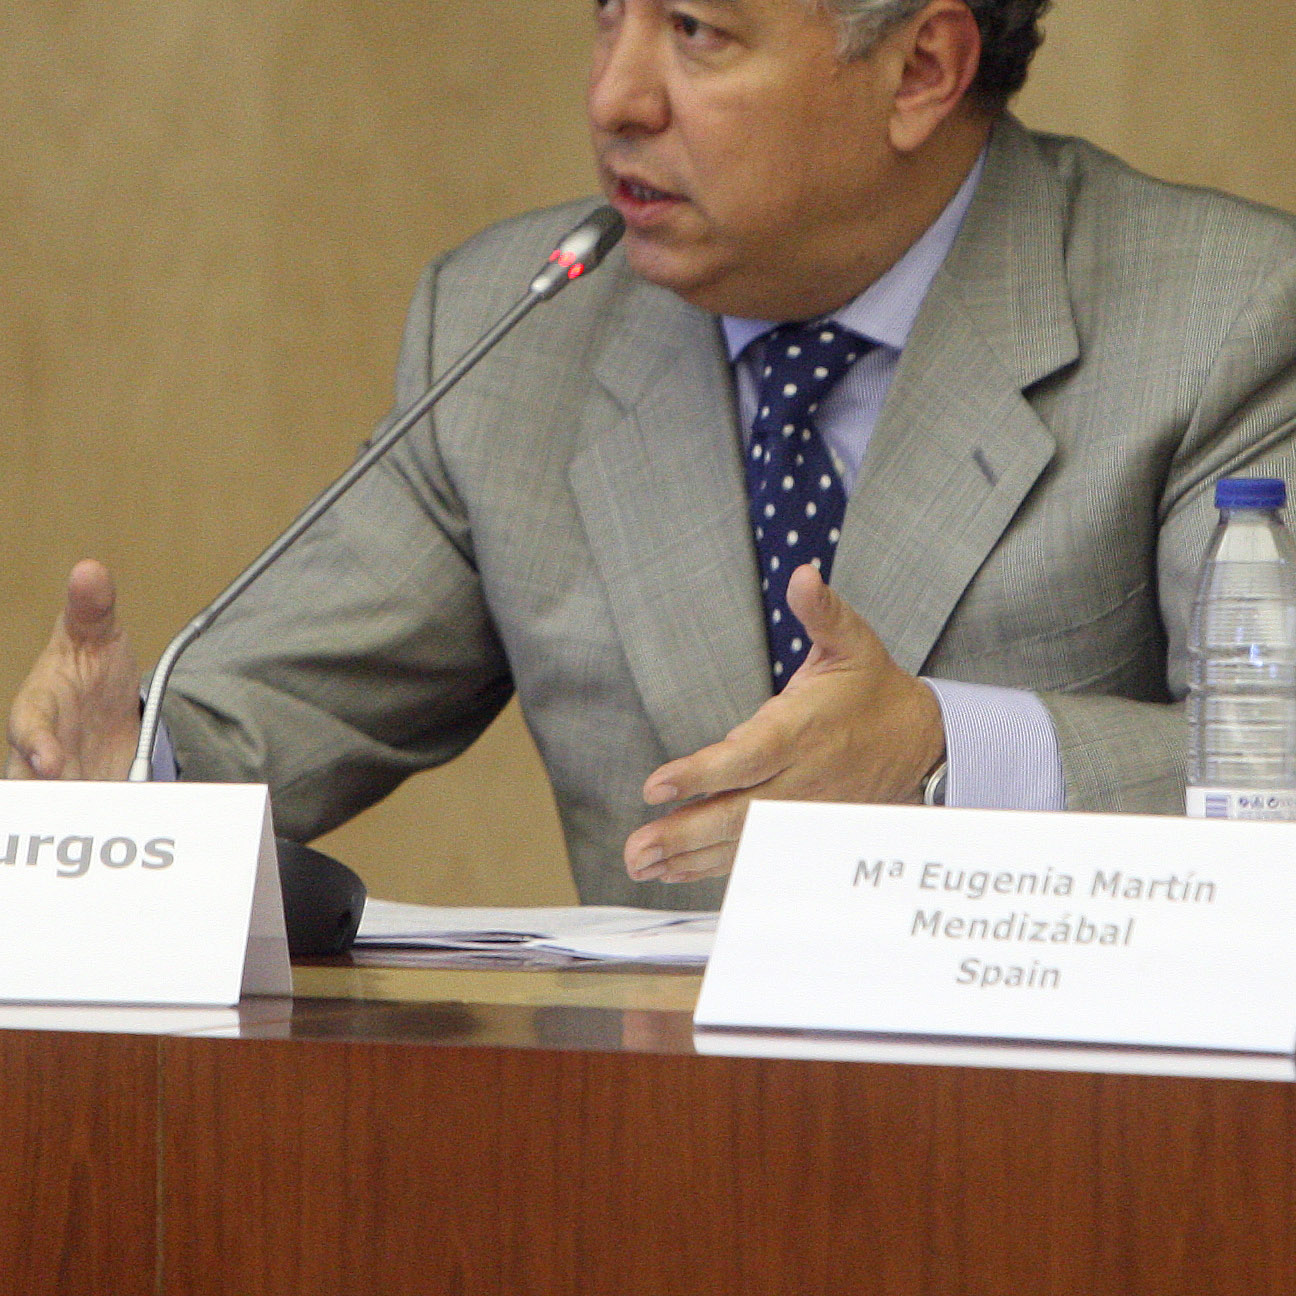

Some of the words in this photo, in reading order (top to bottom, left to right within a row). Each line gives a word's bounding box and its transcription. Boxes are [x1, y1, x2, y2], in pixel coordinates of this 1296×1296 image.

[917, 861, 1075, 901] Eugenia
[1090, 868, 1217, 904] Martín
[909, 908, 1136, 947] Mendizábal
[954, 956, 1062, 991] Spain
